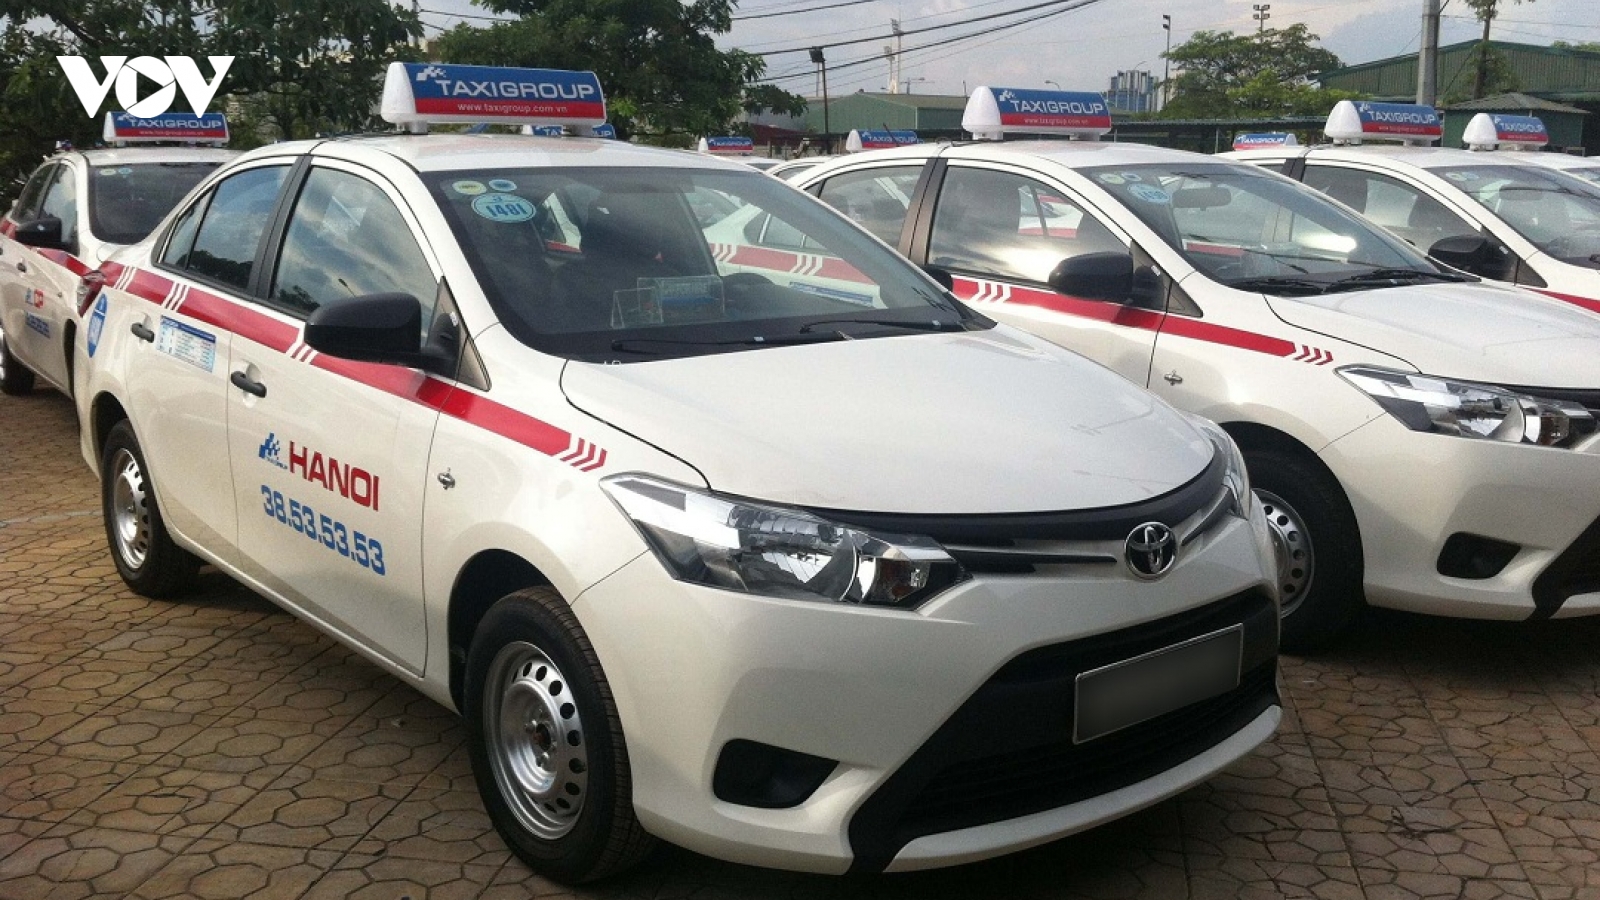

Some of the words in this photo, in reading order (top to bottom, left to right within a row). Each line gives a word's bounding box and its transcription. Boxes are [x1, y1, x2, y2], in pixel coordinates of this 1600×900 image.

[435, 80, 594, 98] TAXIGROUP
[457, 103, 567, 113] www.taxigroup.com.vn
[1010, 100, 1102, 114] TAXIGROUP
[130, 119, 222, 129] TAXIGROUP
[1367, 111, 1435, 124] TAXIGROUP
[485, 203, 528, 217] 1481
[289, 440, 379, 512] HANOI
[260, 484, 385, 576] 38.53.53.53
